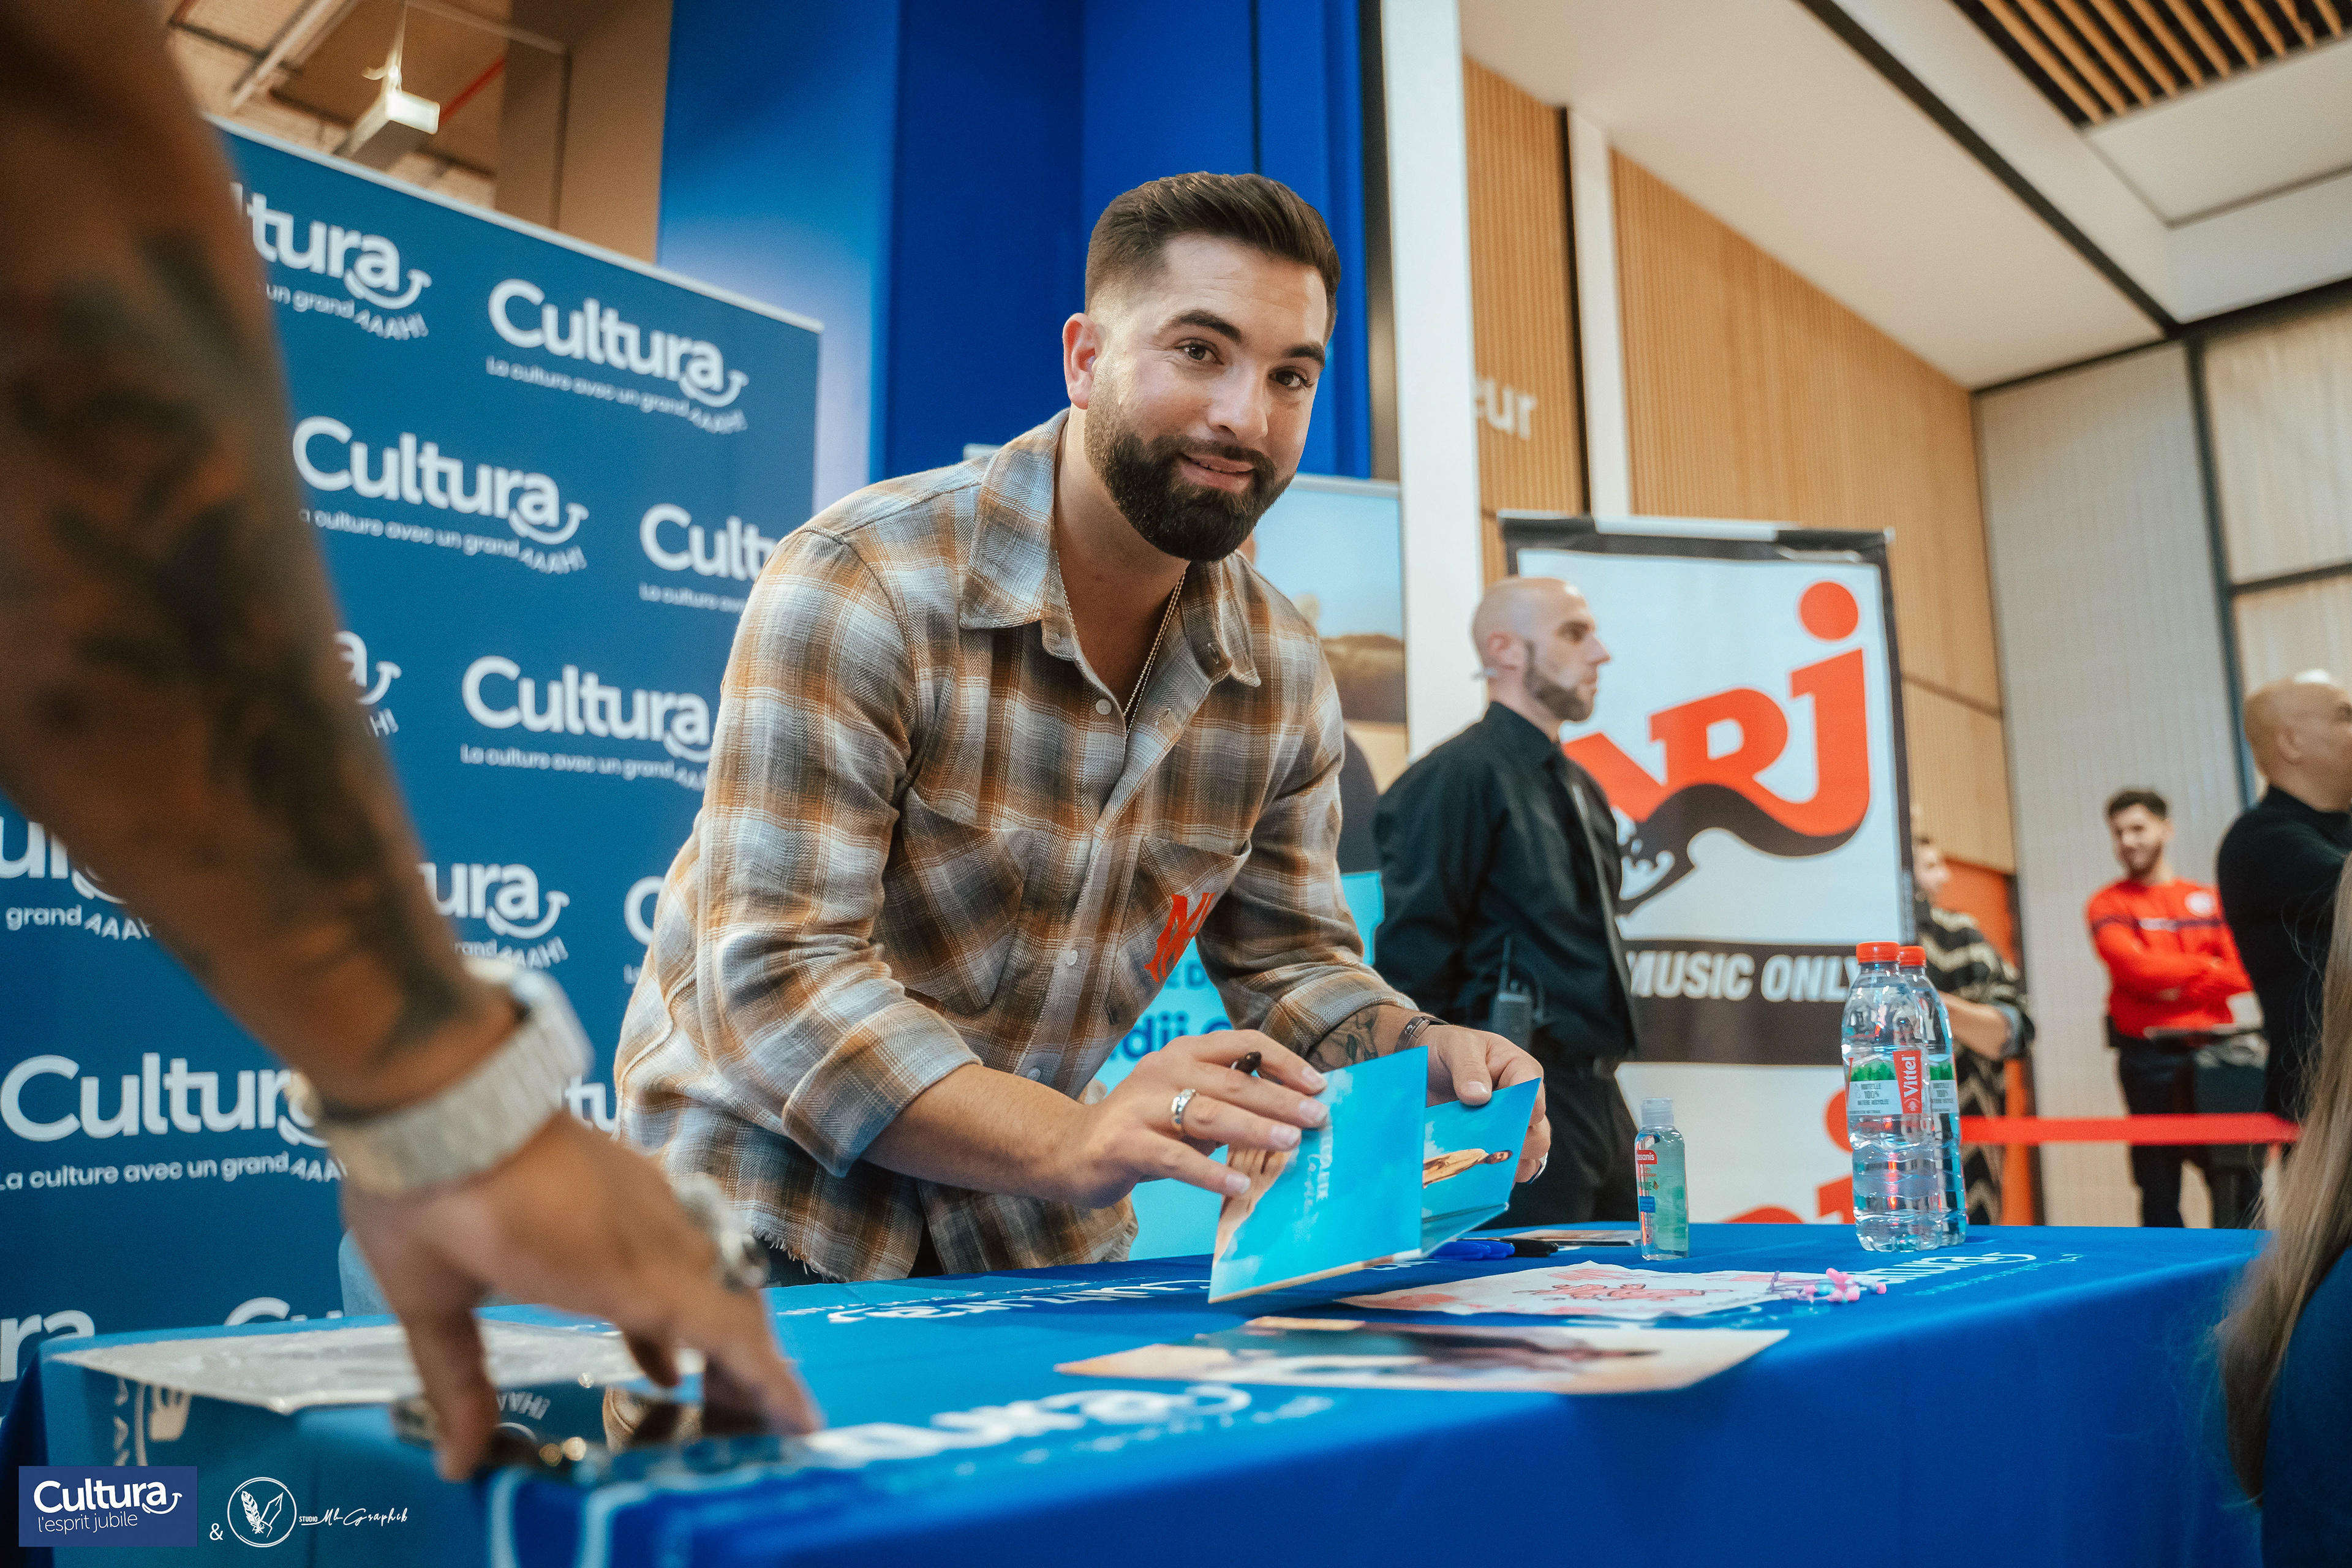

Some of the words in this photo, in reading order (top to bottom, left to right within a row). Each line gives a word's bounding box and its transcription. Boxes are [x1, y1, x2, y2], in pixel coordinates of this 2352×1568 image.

[230, 183, 432, 309] tura
[293, 290, 355, 318] grand
[488, 278, 748, 407] Cultura
[292, 415, 589, 545] Cultura
[639, 503, 776, 581] Cult
[461, 655, 712, 763] Cultura
[6, 904, 82, 931] grand
[83, 913, 151, 941] AAA
[454, 939, 497, 957] rand
[1626, 950, 1755, 1001] MUSIC
[1901, 1056, 1919, 1098] Vittel
[29, 1165, 119, 1189] culture
[124, 1161, 184, 1182] avec
[187, 1159, 217, 1179] un
[221, 1151, 289, 1182] grand
